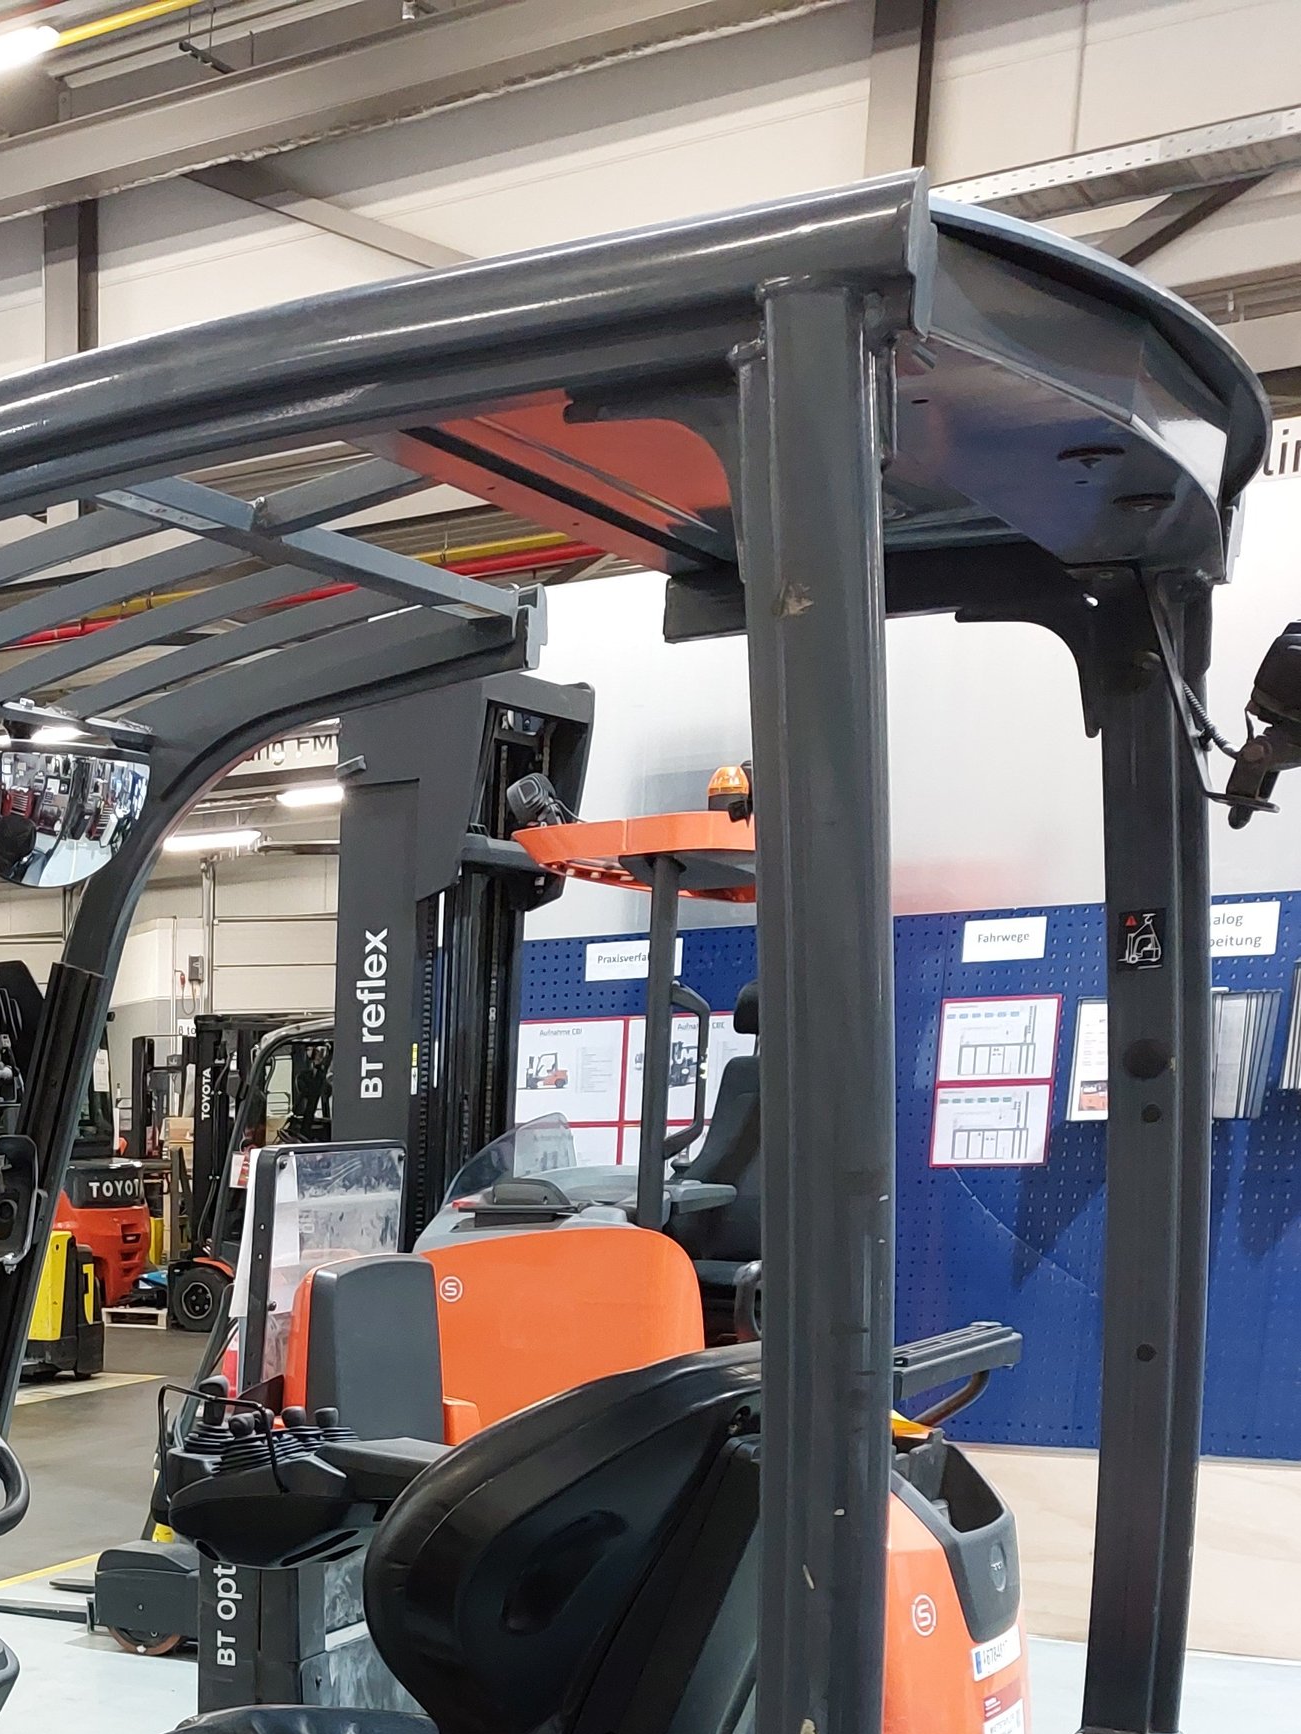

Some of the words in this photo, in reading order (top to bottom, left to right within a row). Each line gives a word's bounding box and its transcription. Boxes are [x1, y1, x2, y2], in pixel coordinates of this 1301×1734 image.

[977, 932, 1030, 943] Fahrwege
[356, 927, 388, 1043] reflex
[201, 1067, 211, 1121] TOYOTA
[360, 1056, 383, 1099] BT
[213, 1564, 243, 1621] opt
[217, 1629, 236, 1667] BT
